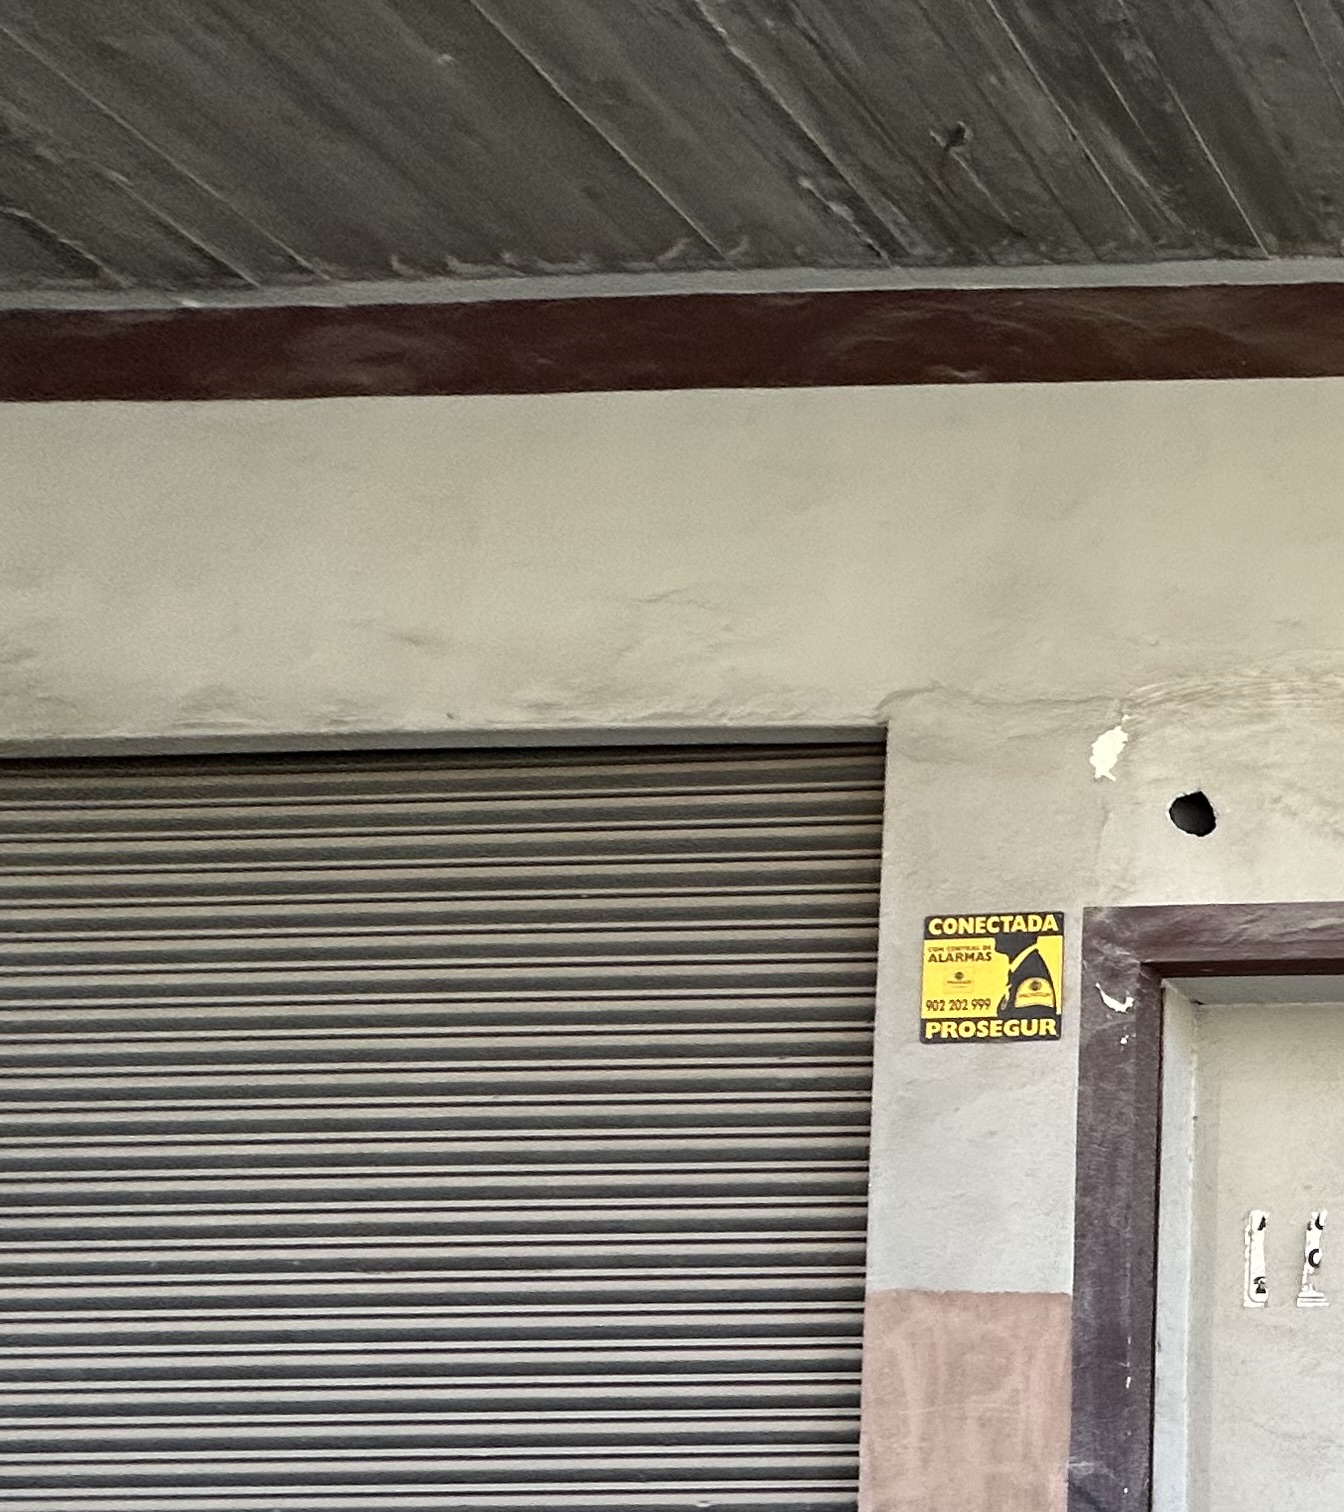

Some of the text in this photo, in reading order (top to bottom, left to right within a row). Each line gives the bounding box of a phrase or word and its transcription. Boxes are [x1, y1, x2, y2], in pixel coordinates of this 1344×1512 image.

[928, 914, 1059, 936] CONECTADA
[928, 951, 992, 963] ALARMAS
[926, 997, 991, 1012] 902 202 999
[925, 1018, 1058, 1039] PROSEGUR
